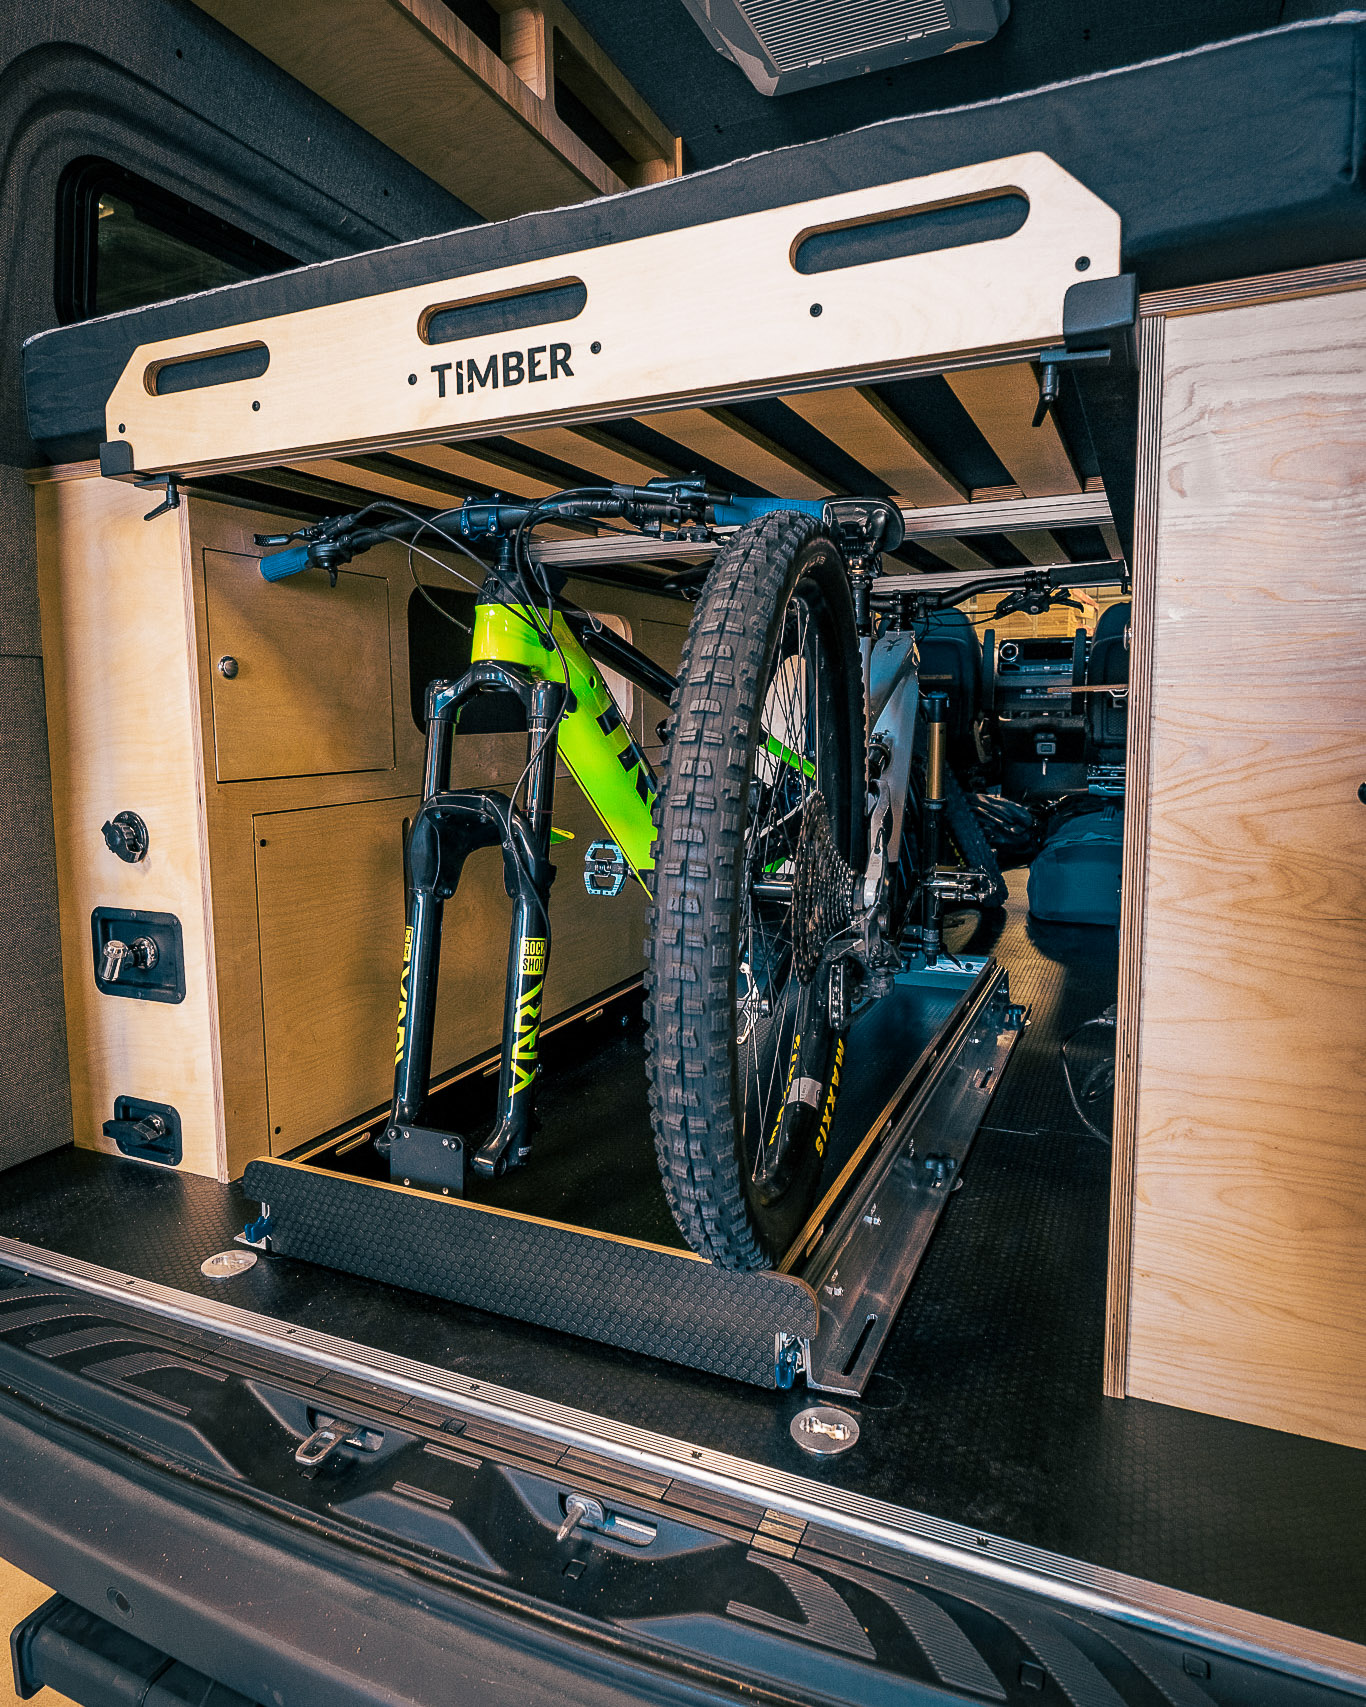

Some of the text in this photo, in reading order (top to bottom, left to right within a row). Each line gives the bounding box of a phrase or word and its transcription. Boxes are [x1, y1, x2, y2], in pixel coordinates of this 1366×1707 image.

[431, 342, 575, 398] TIMBER
[524, 940, 546, 956] ROCK
[815, 1037, 845, 1158] MAXXIS
